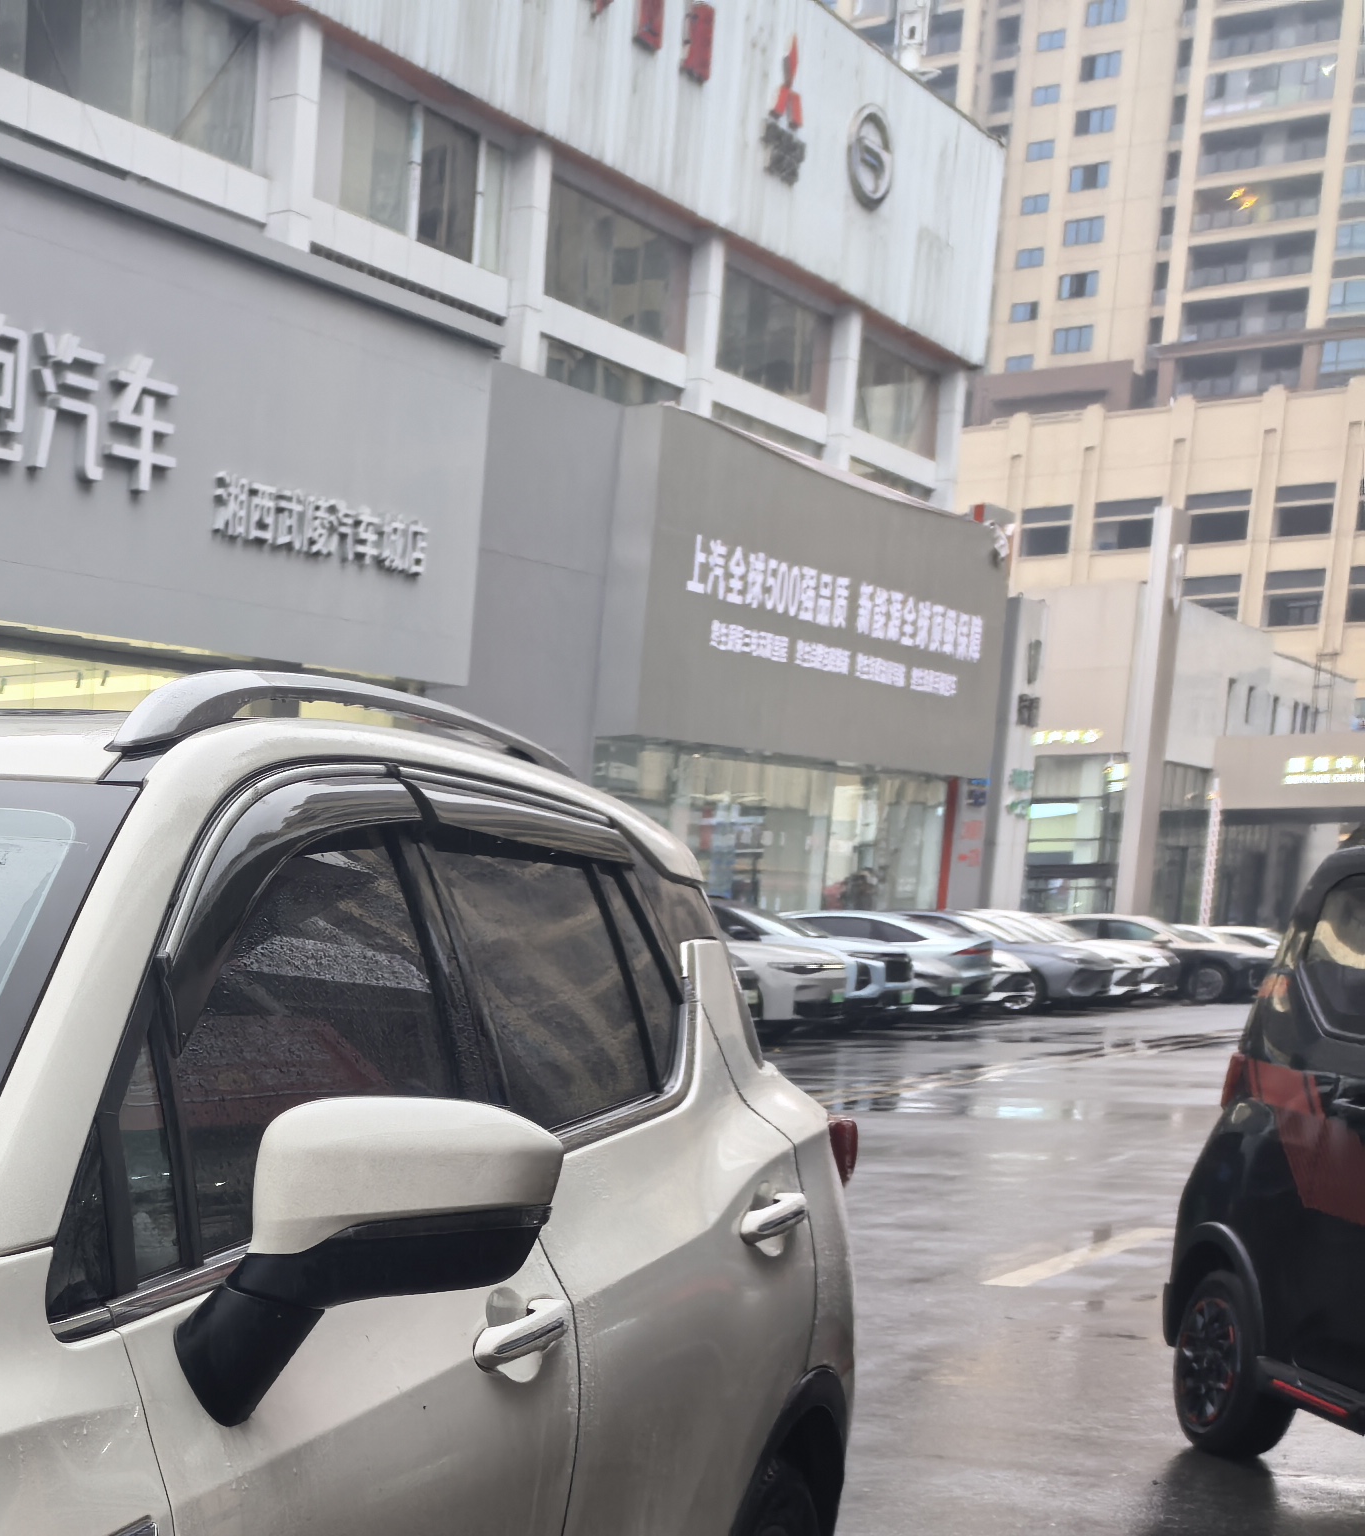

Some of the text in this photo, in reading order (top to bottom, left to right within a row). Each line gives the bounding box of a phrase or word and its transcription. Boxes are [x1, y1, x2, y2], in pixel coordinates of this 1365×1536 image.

[212, 471, 428, 574] 湘西武陵汽车城店
